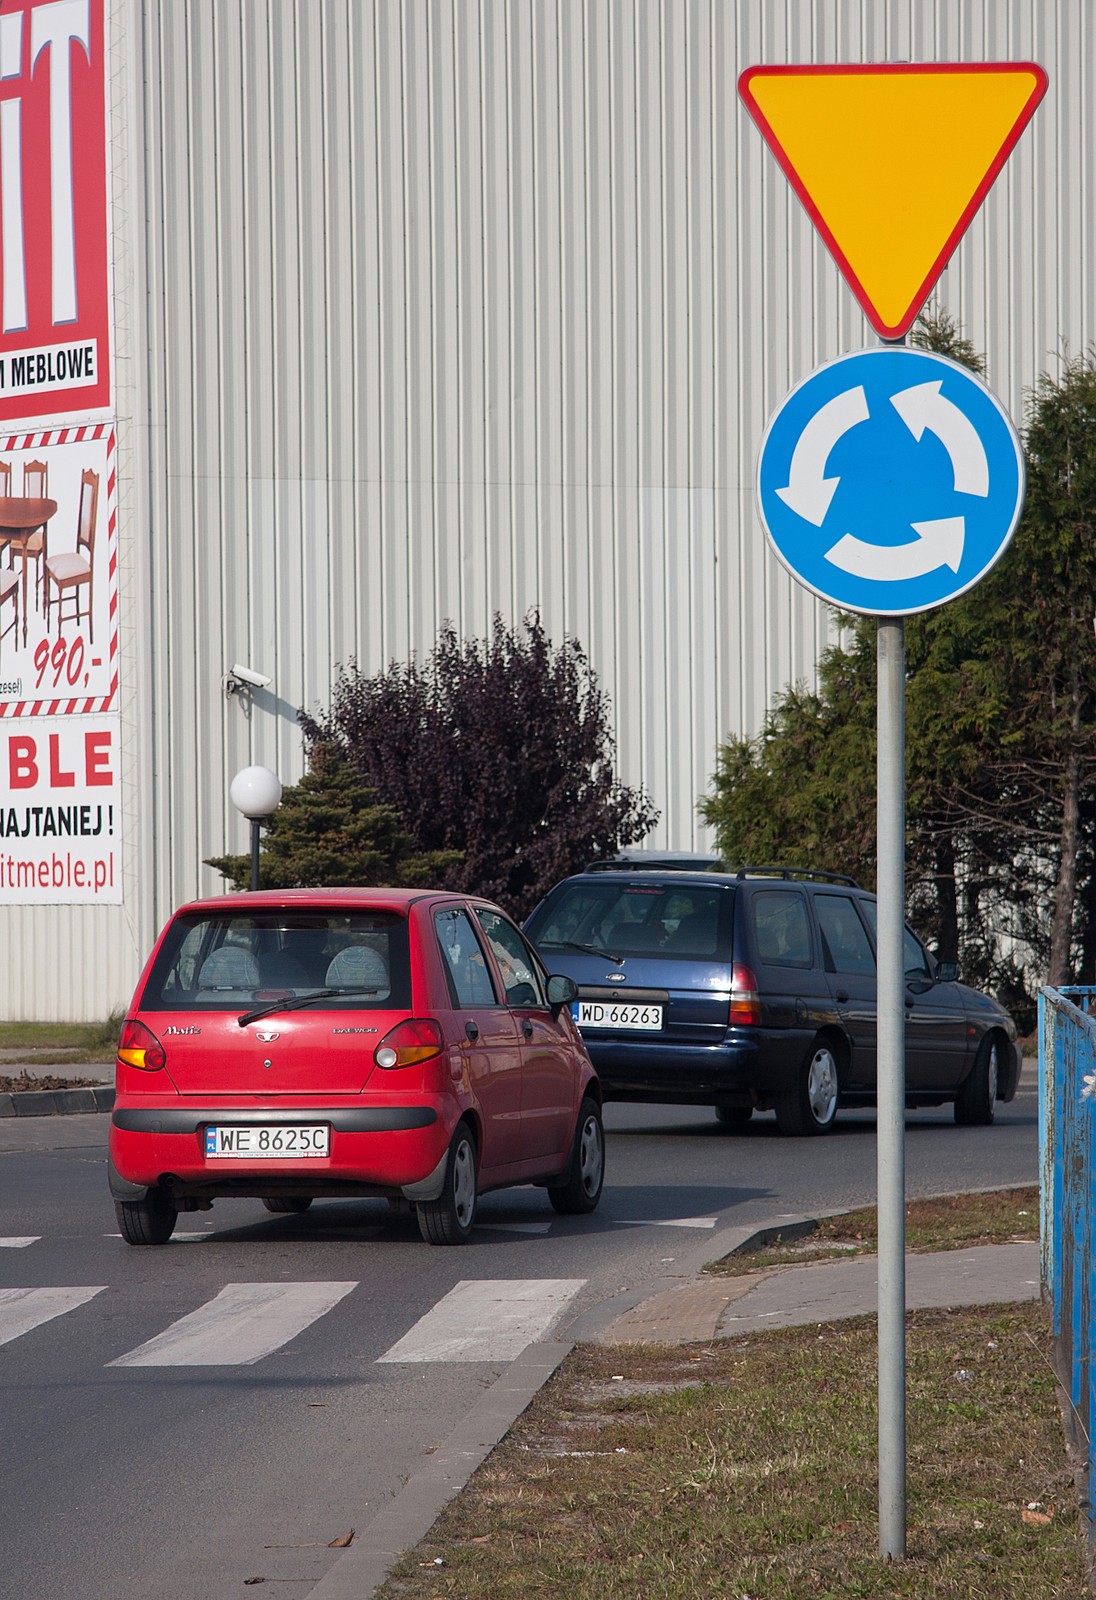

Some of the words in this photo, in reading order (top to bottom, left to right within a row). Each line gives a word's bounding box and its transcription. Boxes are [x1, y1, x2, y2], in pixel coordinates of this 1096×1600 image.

[11, 346, 94, 388] MEBLOWE
[8, 731, 113, 790] BLE
[0, 852, 113, 893] itmeble.pl
[582, 1005, 604, 1022] WD
[610, 1006, 660, 1025] 66263
[161, 1025, 202, 1037] Matiz
[333, 1027, 379, 1035] DAEWOO
[207, 1142, 216, 1150] PL
[220, 1130, 250, 1151] WE
[258, 1129, 325, 1151] 8625C
